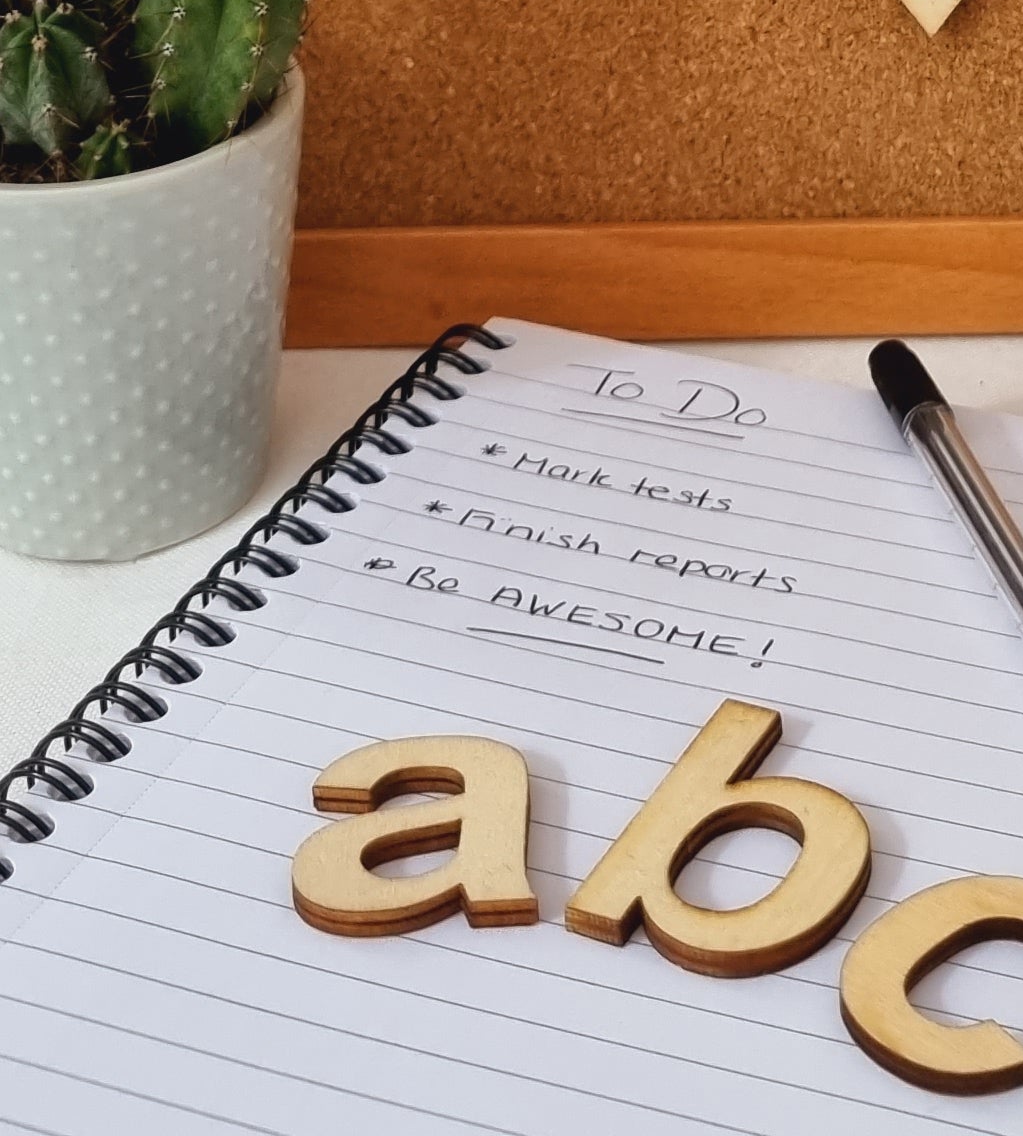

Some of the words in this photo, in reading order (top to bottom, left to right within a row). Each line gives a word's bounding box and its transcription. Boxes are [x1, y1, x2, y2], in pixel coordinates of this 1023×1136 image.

[567, 362, 645, 401] To
[660, 378, 767, 427] Do
[513, 451, 613, 488] Mark
[632, 476, 733, 513] tests
[405, 564, 459, 594] Be
[459, 507, 600, 556] Finish
[630, 547, 799, 595] reports
